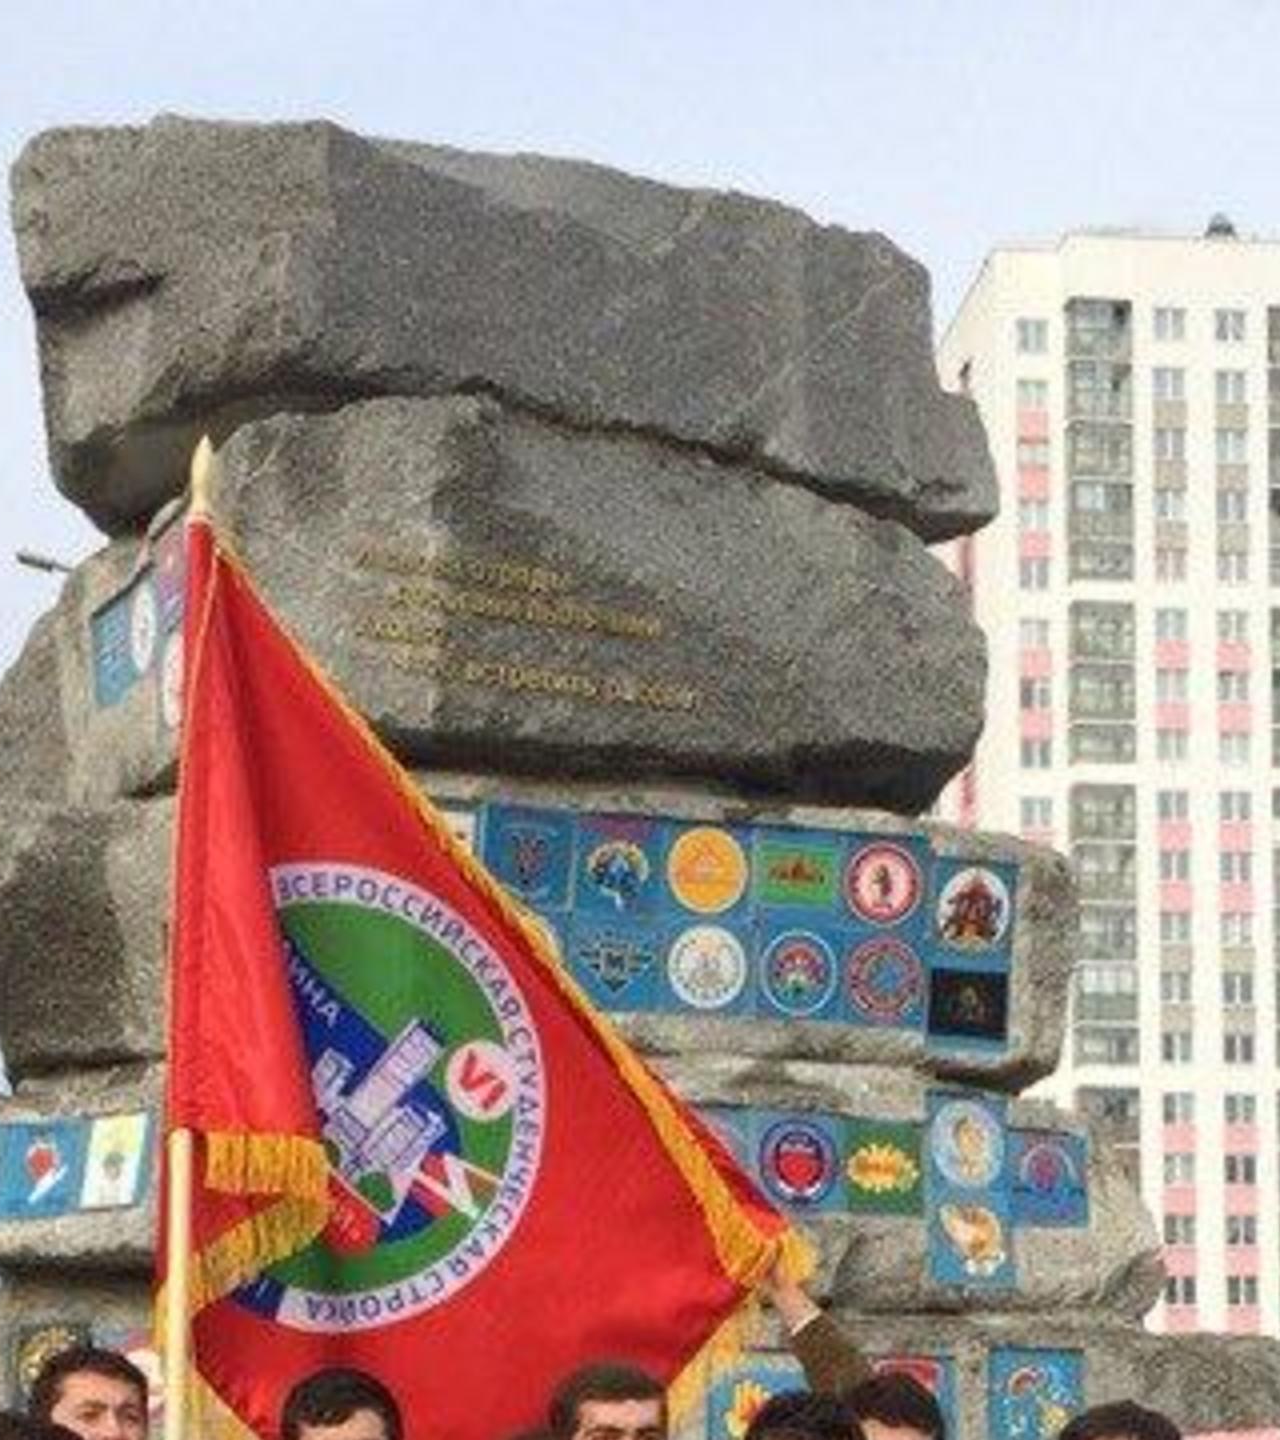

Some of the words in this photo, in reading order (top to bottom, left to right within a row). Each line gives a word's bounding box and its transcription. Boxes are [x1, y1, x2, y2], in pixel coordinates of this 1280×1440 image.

[458, 1049, 508, 1112] VI
[451, 1026, 541, 1278] СТУДЕНЧЕСКАЯ
[305, 1273, 447, 1326] СТРОЙКА
